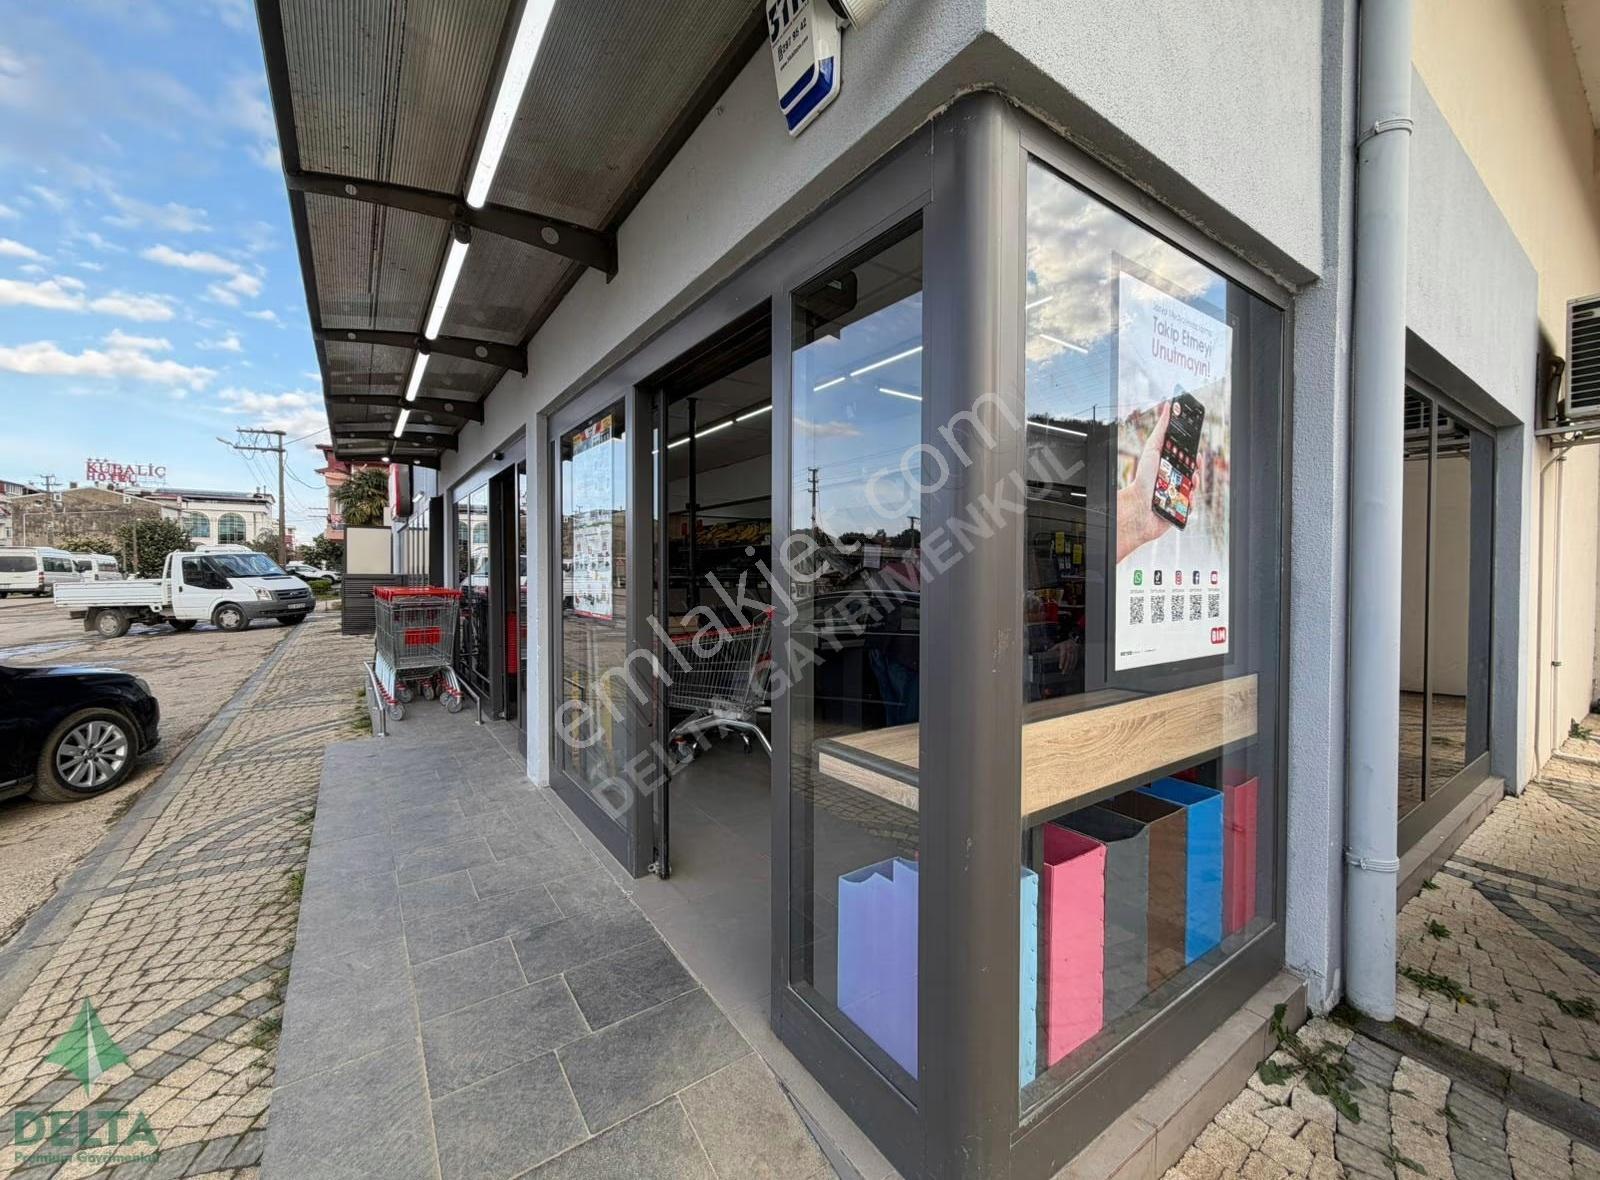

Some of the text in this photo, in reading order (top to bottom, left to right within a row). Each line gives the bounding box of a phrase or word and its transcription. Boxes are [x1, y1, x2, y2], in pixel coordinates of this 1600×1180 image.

[1152, 337, 1211, 377] Unutmayın!
[1153, 316, 1180, 345] Takip
[1182, 330, 1212, 358] Etmeyi
